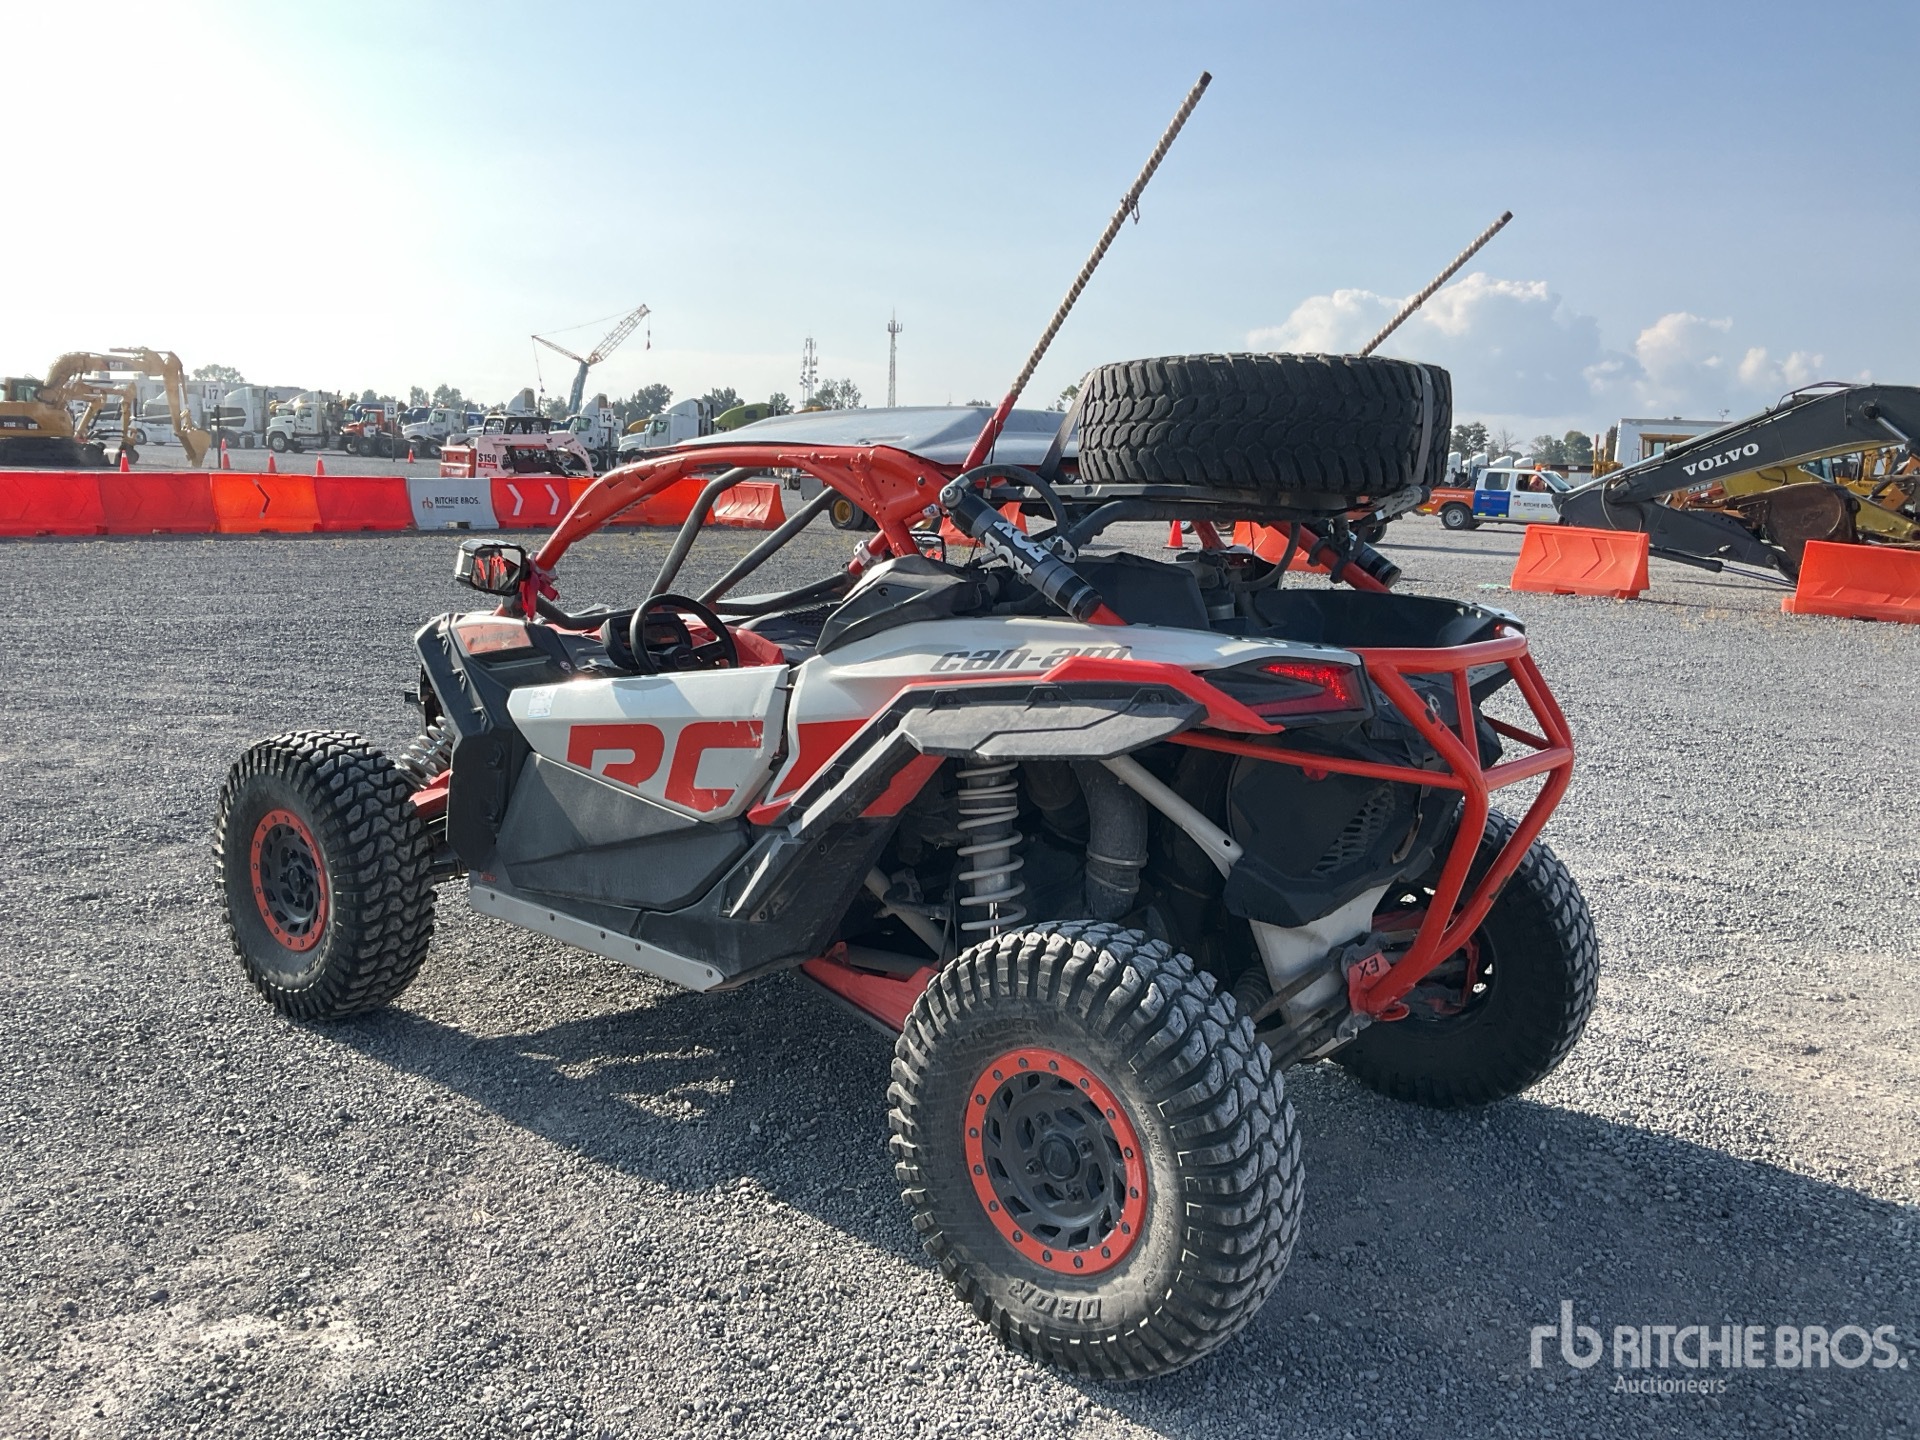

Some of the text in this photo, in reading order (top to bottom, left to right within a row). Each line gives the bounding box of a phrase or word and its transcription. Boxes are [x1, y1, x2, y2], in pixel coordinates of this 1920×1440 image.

[109, 361, 124, 370] CAT
[208, 388, 219, 400] 17
[386, 407, 395, 415] 13
[601, 413, 612, 424] 14
[478, 453, 497, 463] S150
[1682, 443, 1760, 476] VOLVO
[422, 496, 434, 509] rb
[434, 496, 459, 505] RITCHIE
[984, 531, 1033, 577] FOX
